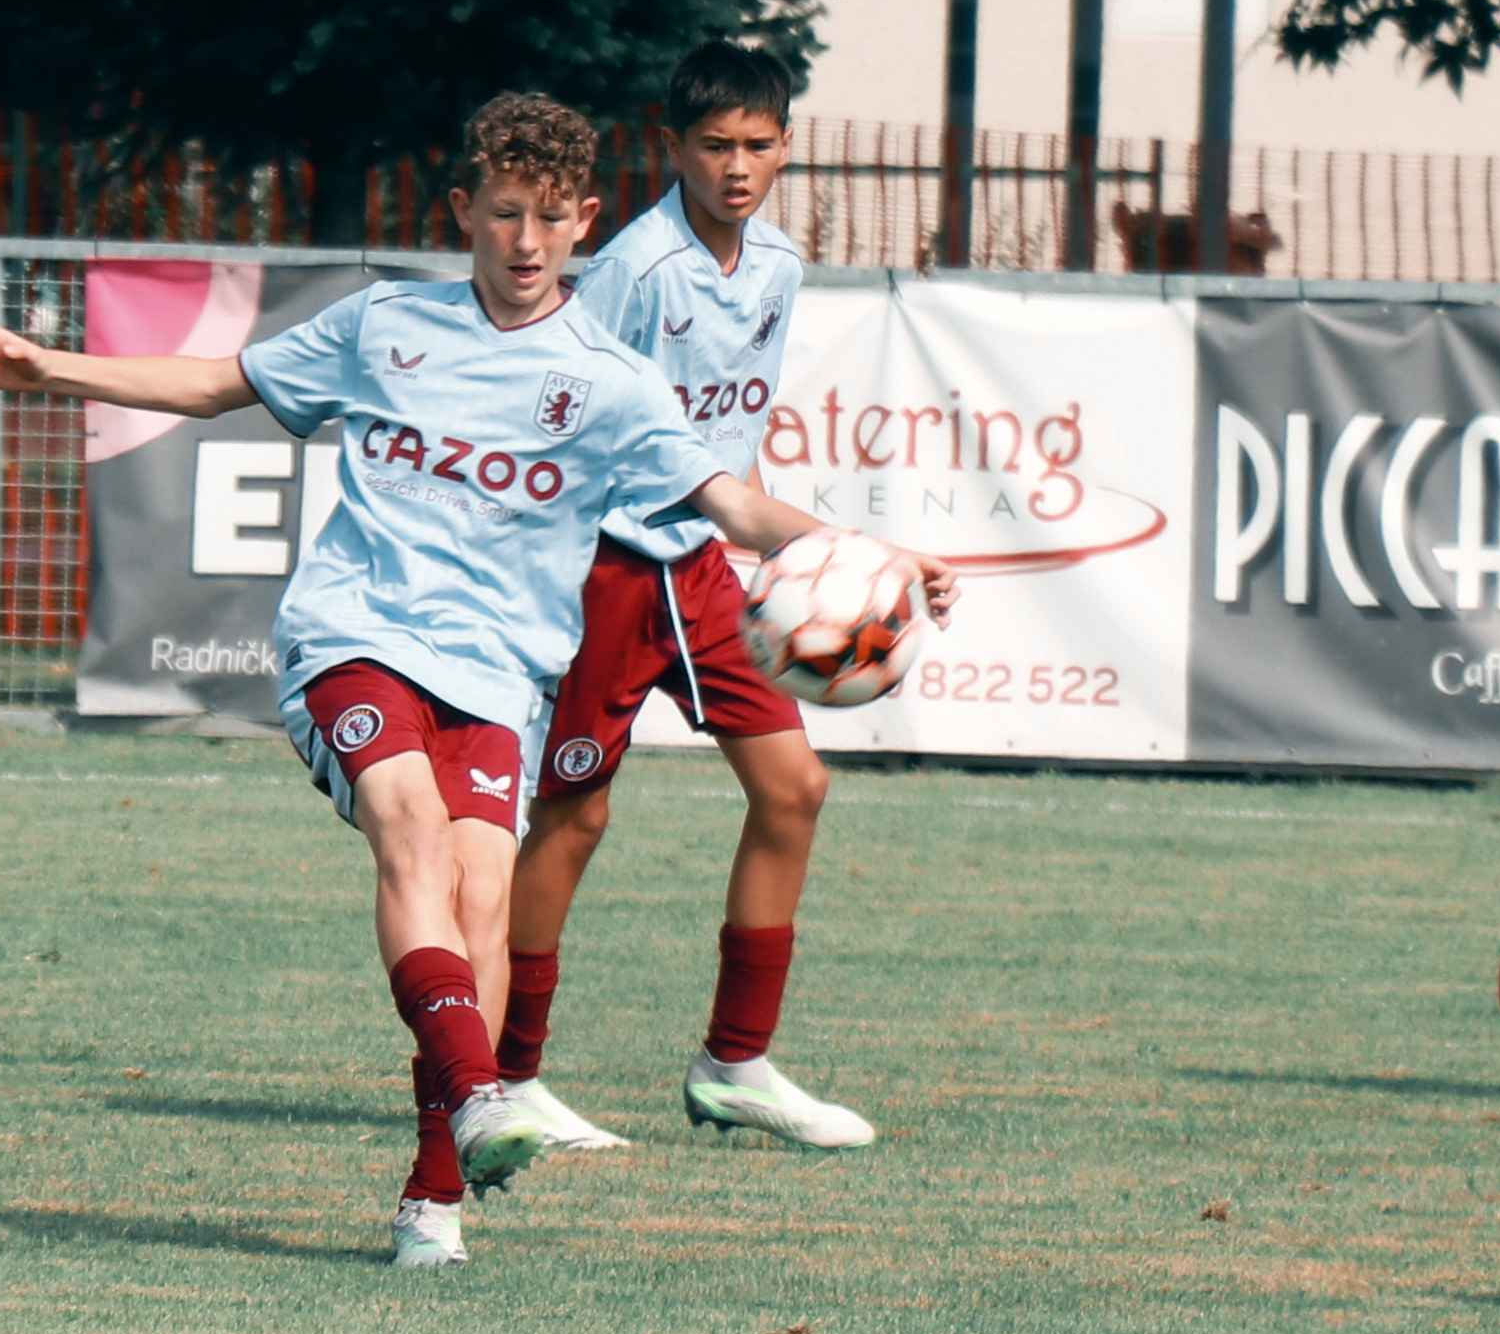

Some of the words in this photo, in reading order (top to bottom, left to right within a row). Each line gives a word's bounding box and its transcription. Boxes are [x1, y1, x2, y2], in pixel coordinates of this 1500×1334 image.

[363, 420, 563, 502] CAZOO
[761, 387, 1084, 522] atering
[770, 484, 1017, 520] KENA
[151, 636, 279, 676] Radničk
[919, 662, 1012, 703] 822
[1027, 666, 1121, 707] 522
[426, 995, 480, 1012] VILL
